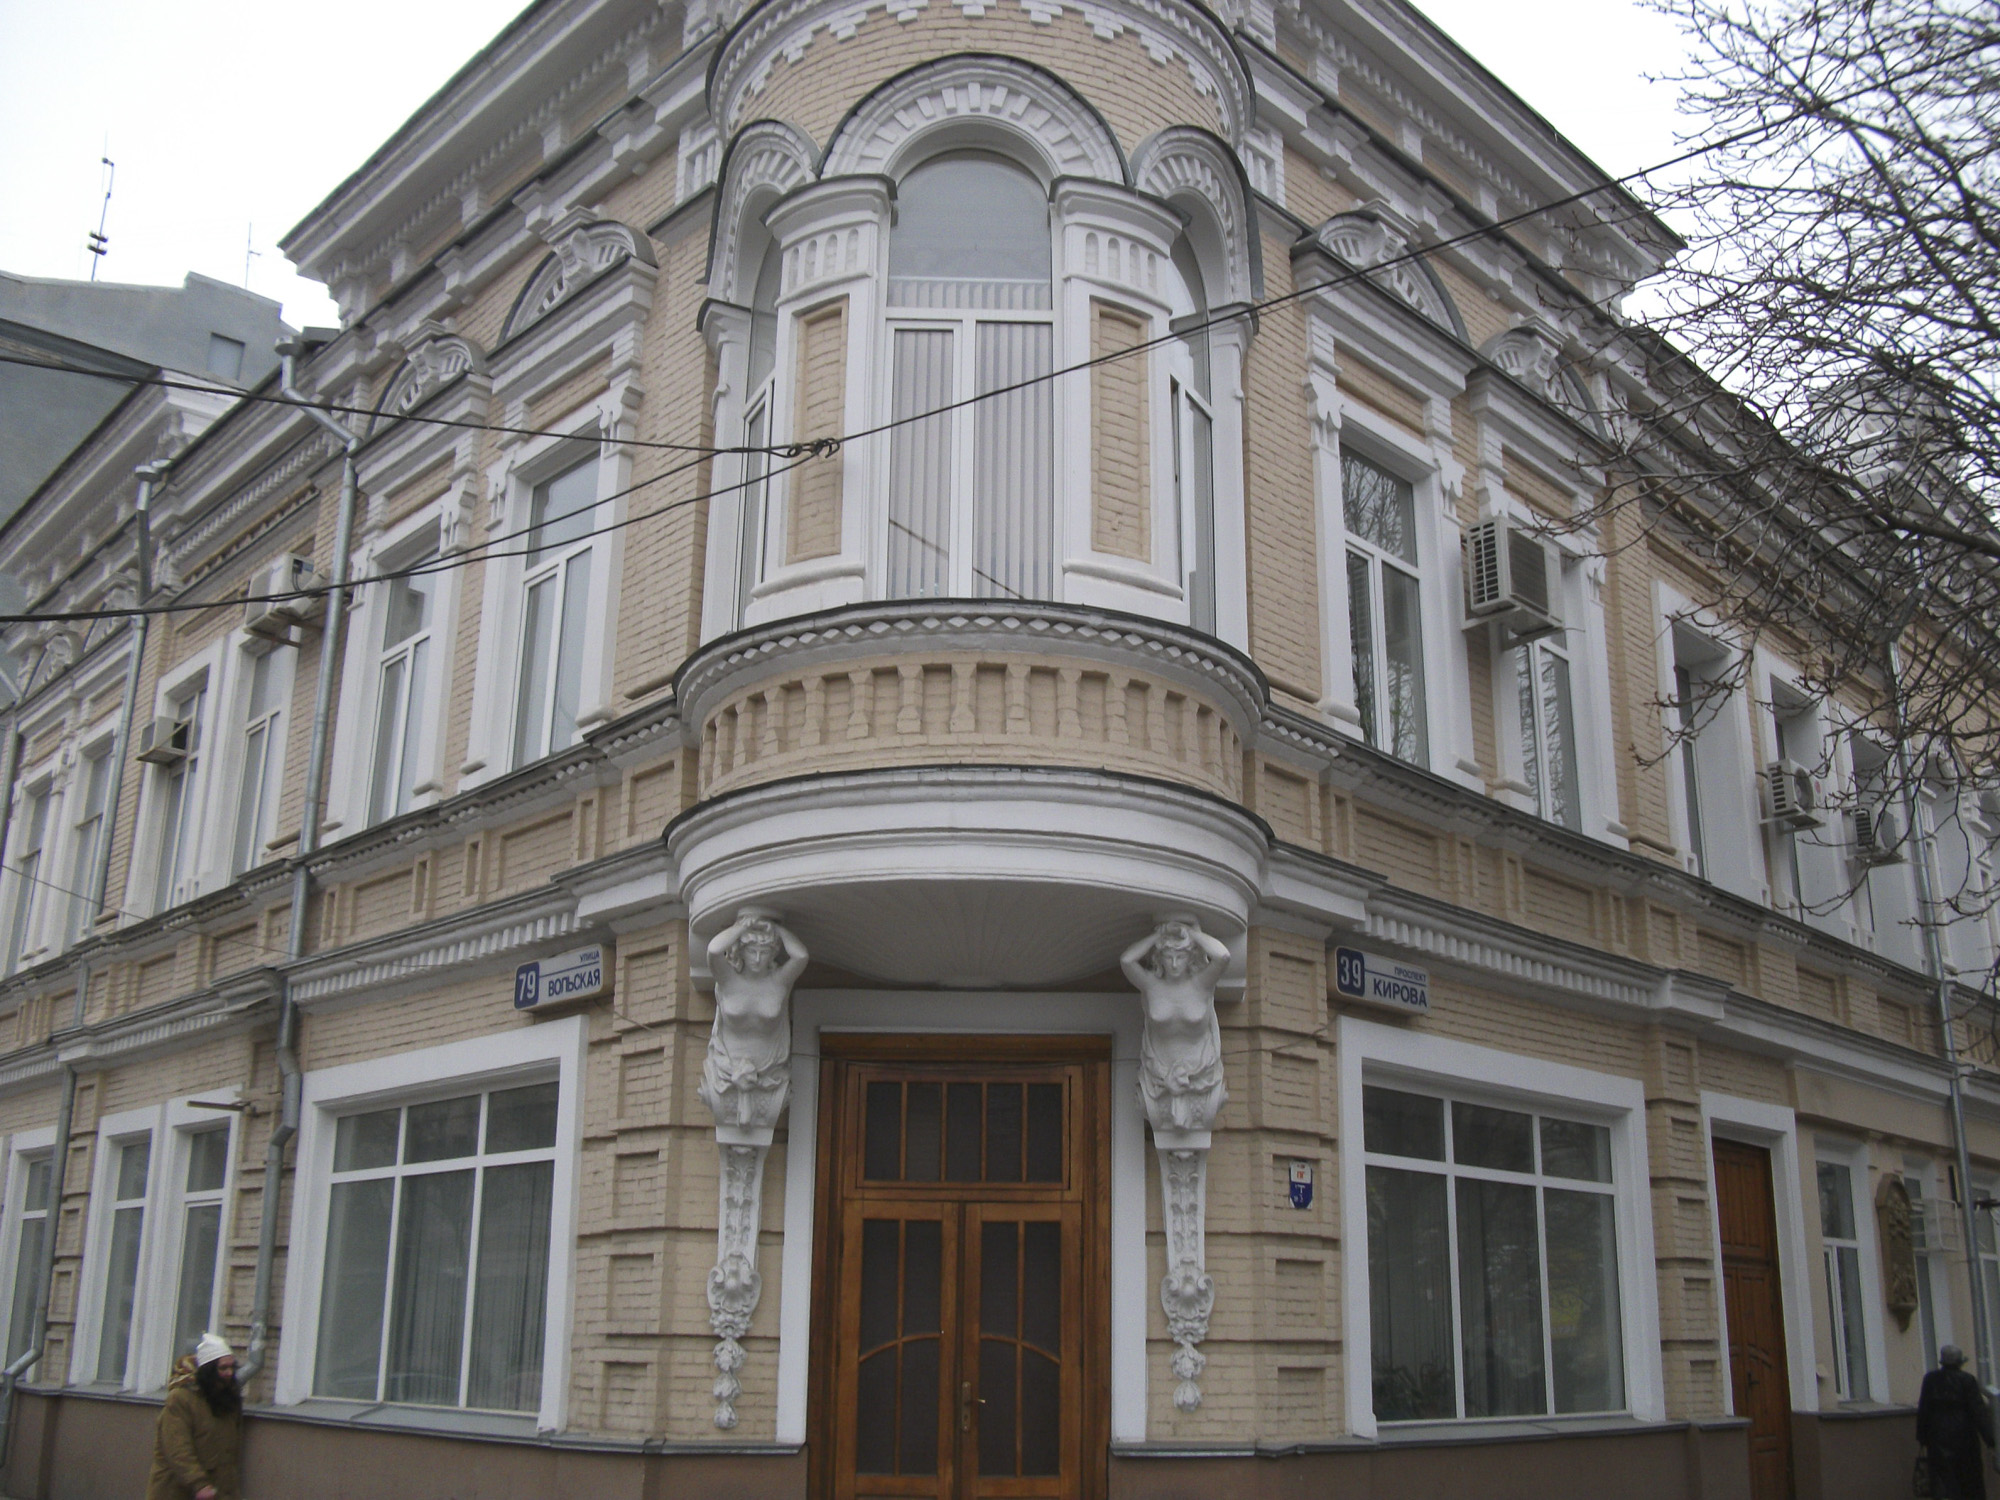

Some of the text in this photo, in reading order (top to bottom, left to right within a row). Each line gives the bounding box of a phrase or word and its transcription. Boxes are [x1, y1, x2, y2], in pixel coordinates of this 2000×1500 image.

[579, 950, 600, 962] УЛИЦА
[518, 971, 536, 1001] 79
[548, 968, 601, 997] ВОЛЬСКАЯ
[1340, 956, 1360, 988] 39
[1394, 966, 1427, 982] ПРОСПЕКТ
[1373, 978, 1428, 1008] КИРОВА
